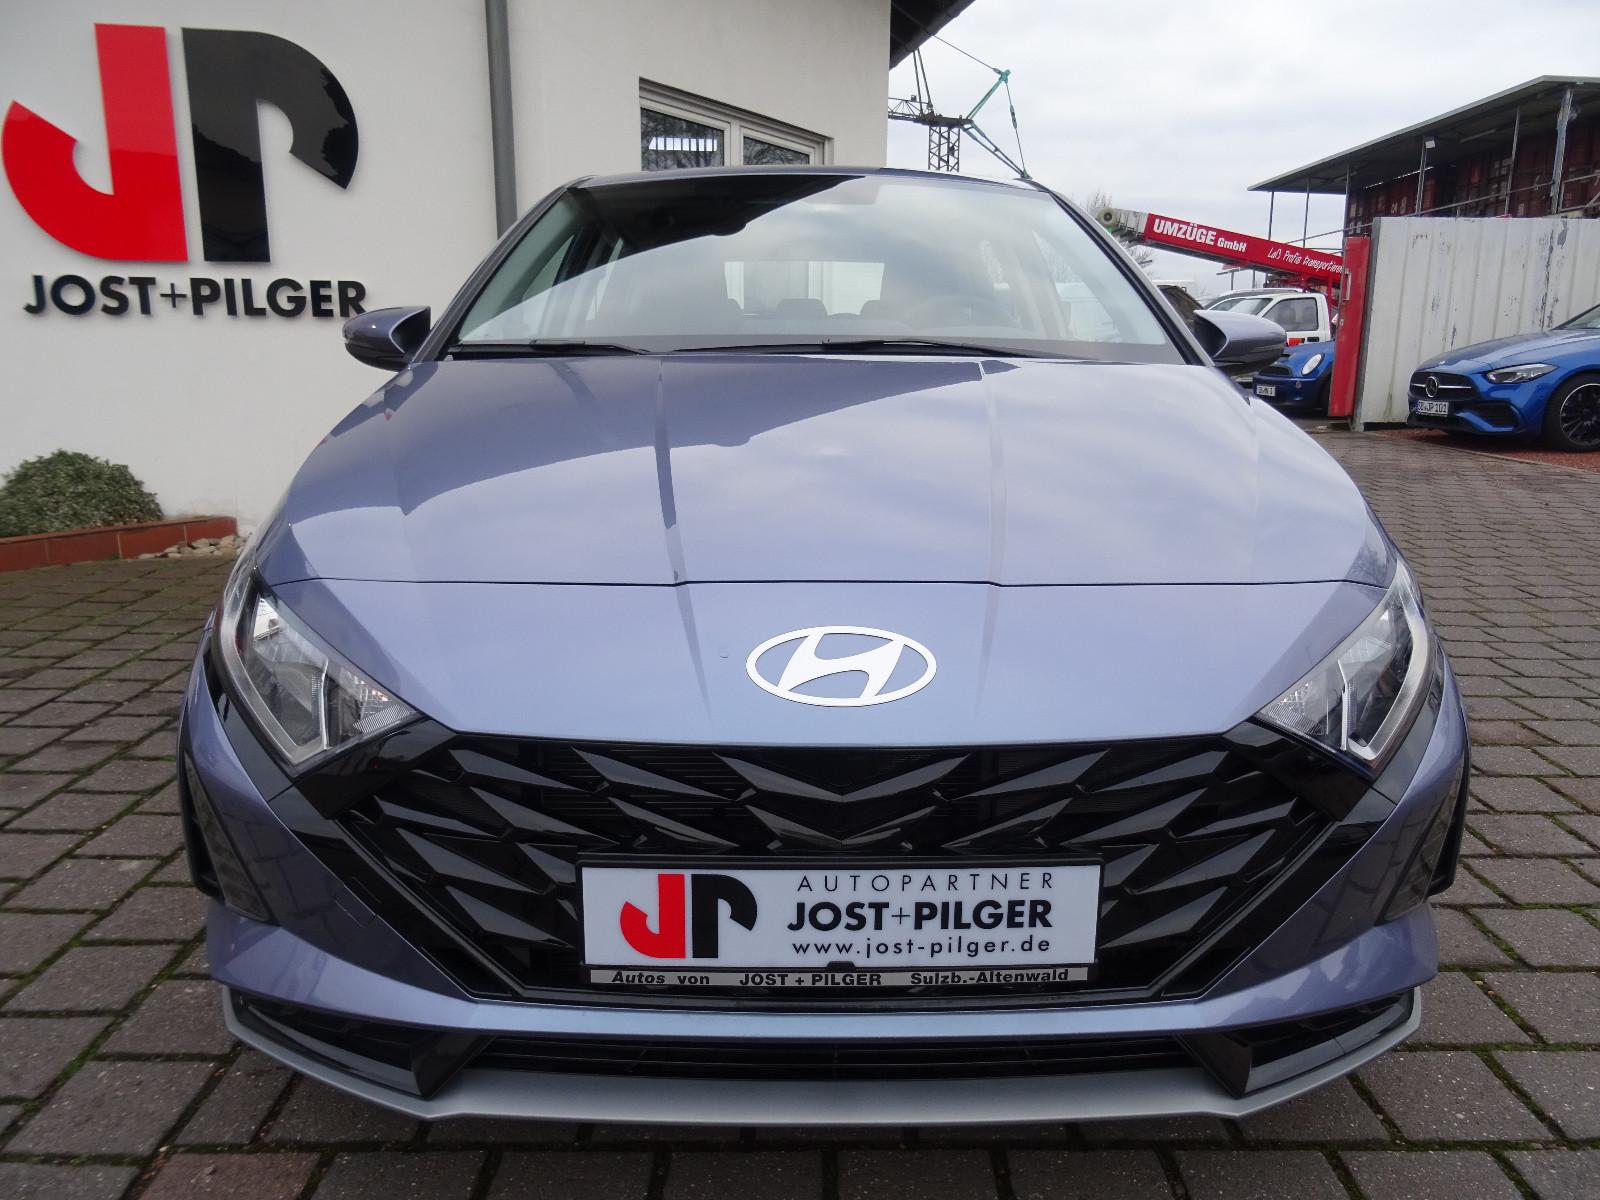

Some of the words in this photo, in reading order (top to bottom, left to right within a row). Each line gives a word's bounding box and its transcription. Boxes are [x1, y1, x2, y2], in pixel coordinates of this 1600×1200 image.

[1153, 218, 1217, 246] UMZÜGE
[1217, 237, 1247, 253] GmbH
[1267, 247, 1282, 260] Laß
[1282, 250, 1302, 265] Profis
[24, 274, 367, 317] JOST+PILGER
[797, 872, 1053, 892] AUTOPARTNER
[787, 900, 1053, 931] JOST+PILGER
[792, 935, 1051, 958] www.jost-pilger.de
[612, 971, 666, 985] Autos
[677, 974, 710, 985] von
[739, 973, 789, 986] JOST
[811, 973, 882, 986] PILGER
[910, 968, 1069, 985] Sulzb.-Altenwald
